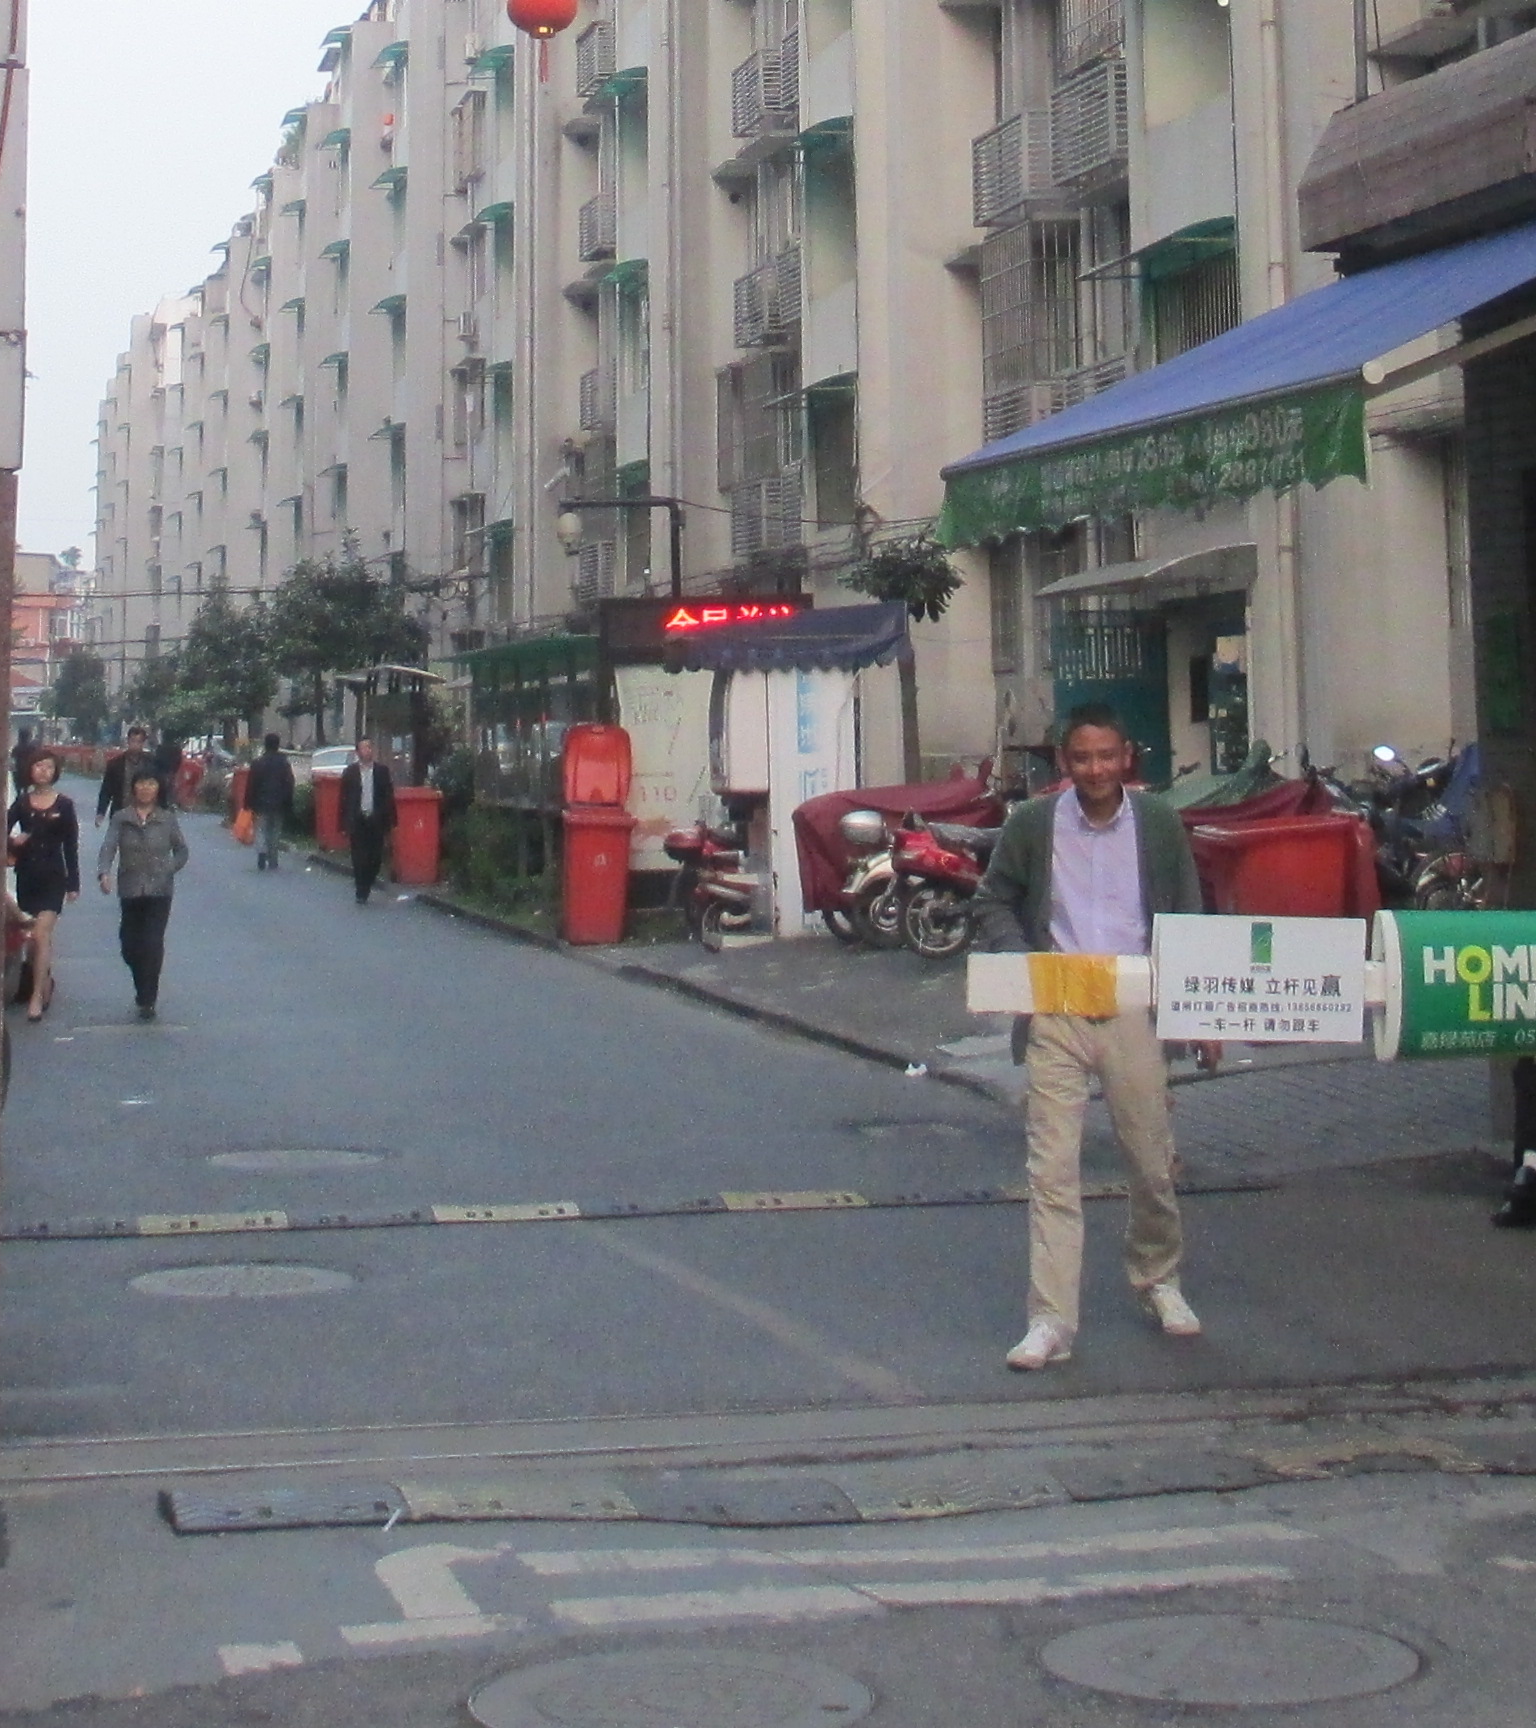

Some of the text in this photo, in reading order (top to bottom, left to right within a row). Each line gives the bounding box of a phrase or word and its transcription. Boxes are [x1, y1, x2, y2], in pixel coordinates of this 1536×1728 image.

[1184, 973, 1342, 997] 绿羽传媒 立杆见赢
